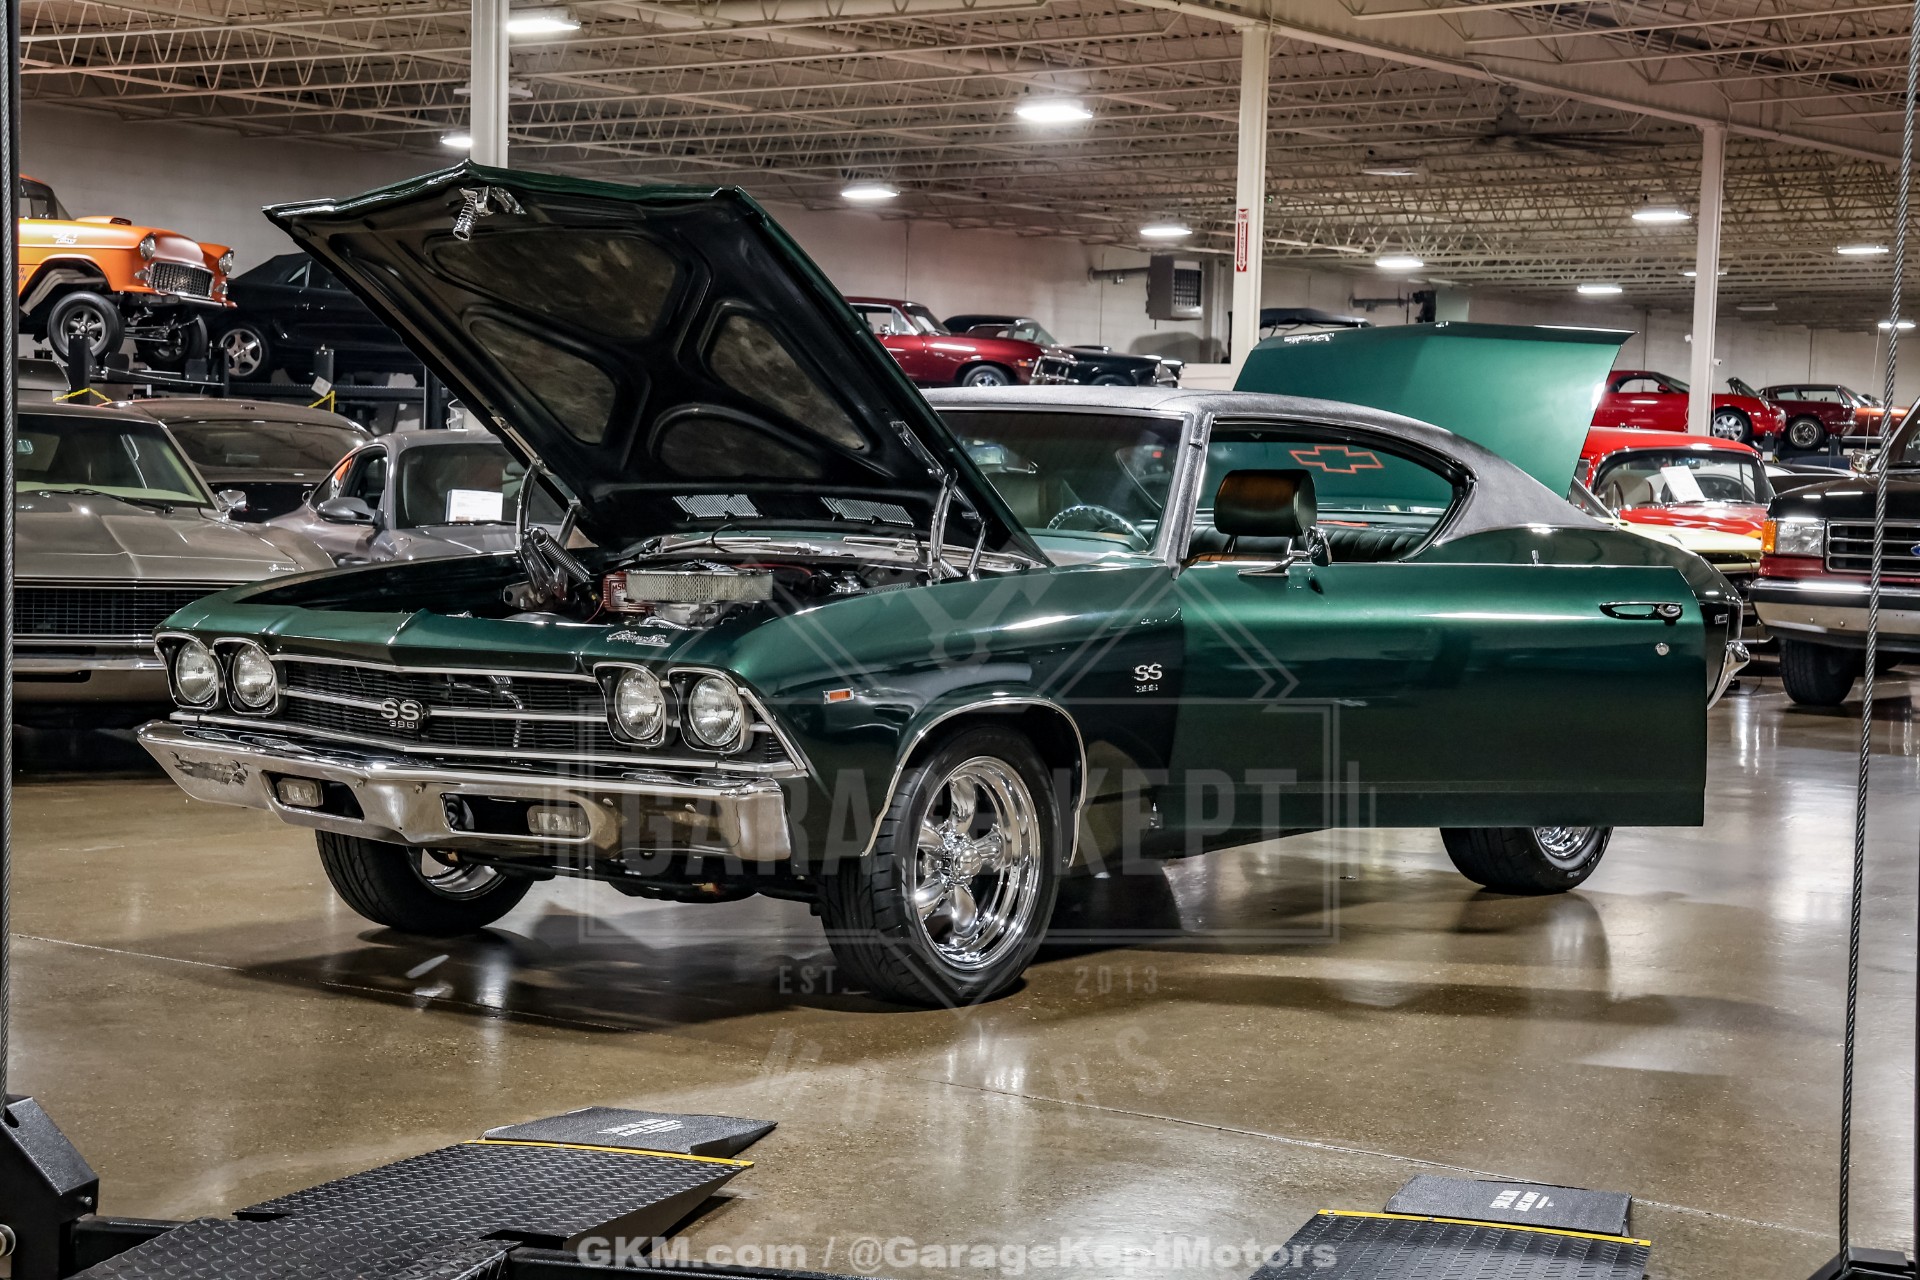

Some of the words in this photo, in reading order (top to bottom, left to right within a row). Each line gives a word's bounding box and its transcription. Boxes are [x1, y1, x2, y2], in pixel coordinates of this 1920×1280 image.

[1133, 663, 1163, 681] SS
[380, 700, 420, 720] SS
[389, 719, 415, 729] 396
